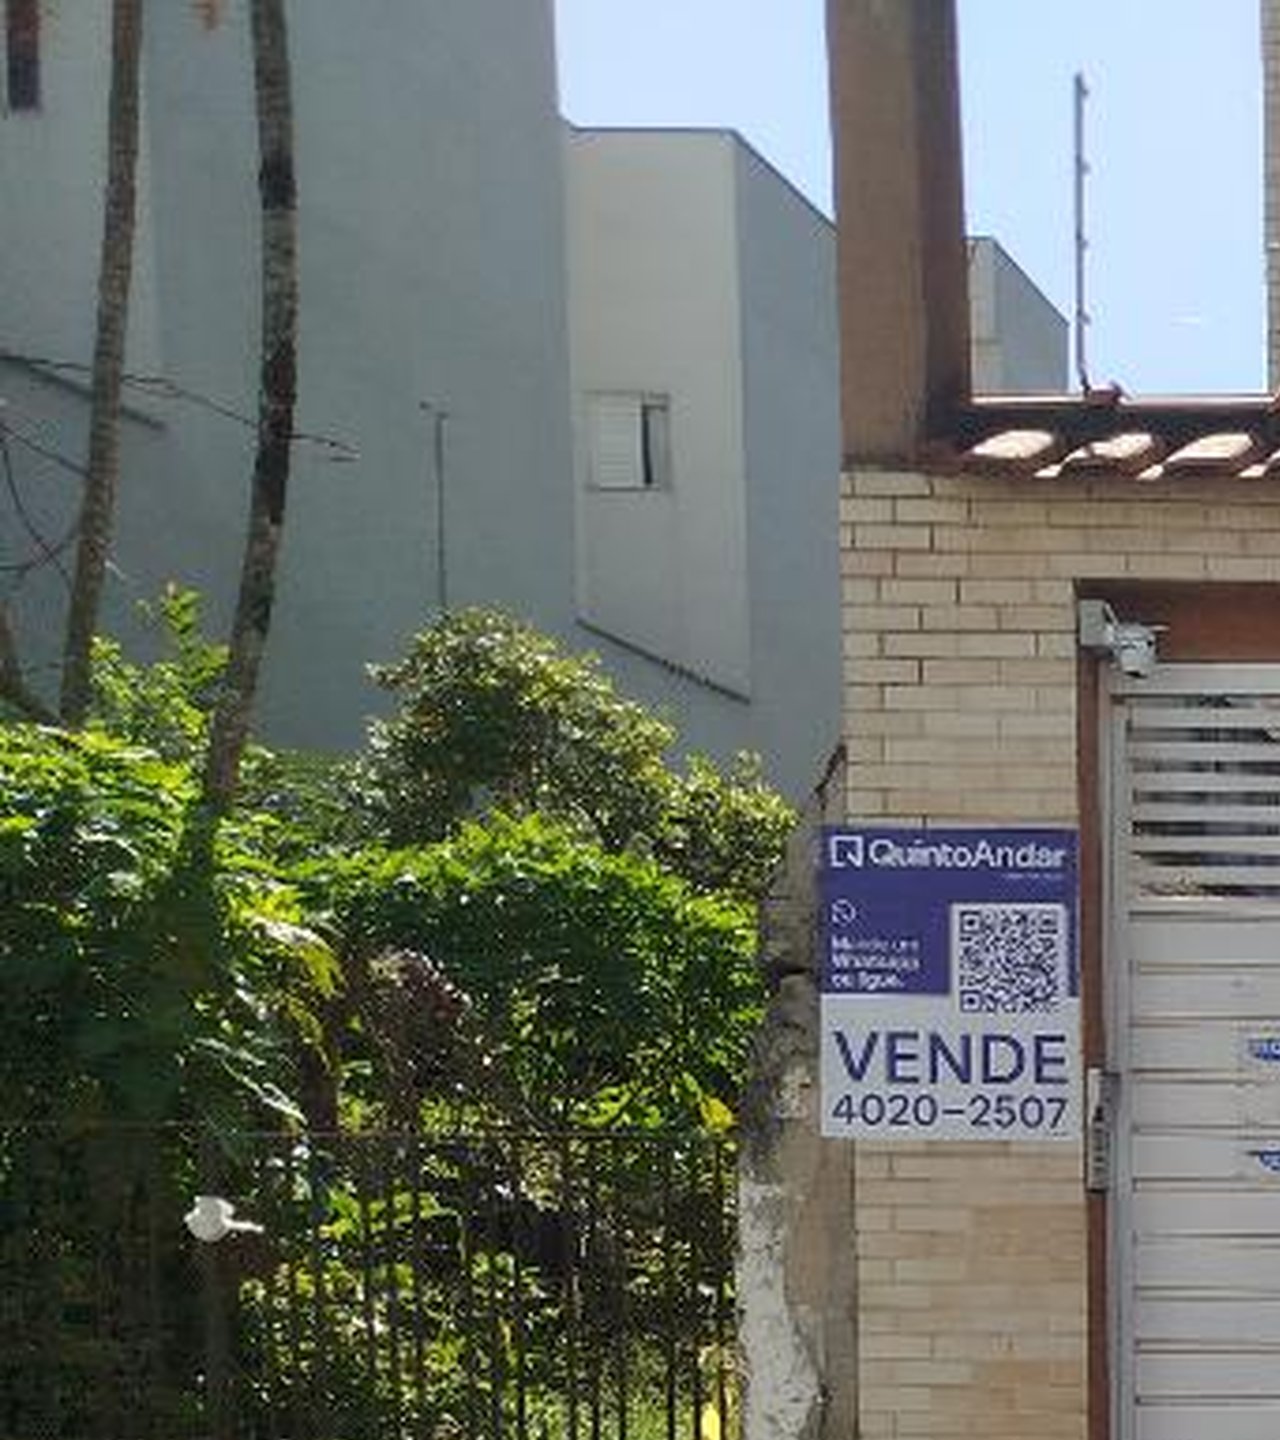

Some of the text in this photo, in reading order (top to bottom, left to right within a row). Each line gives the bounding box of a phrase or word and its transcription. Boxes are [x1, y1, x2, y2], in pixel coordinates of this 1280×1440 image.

[868, 838, 1067, 869] QuintoAndar
[832, 1030, 1069, 1084] VENDE
[832, 1094, 1069, 1129] 4020-2507
